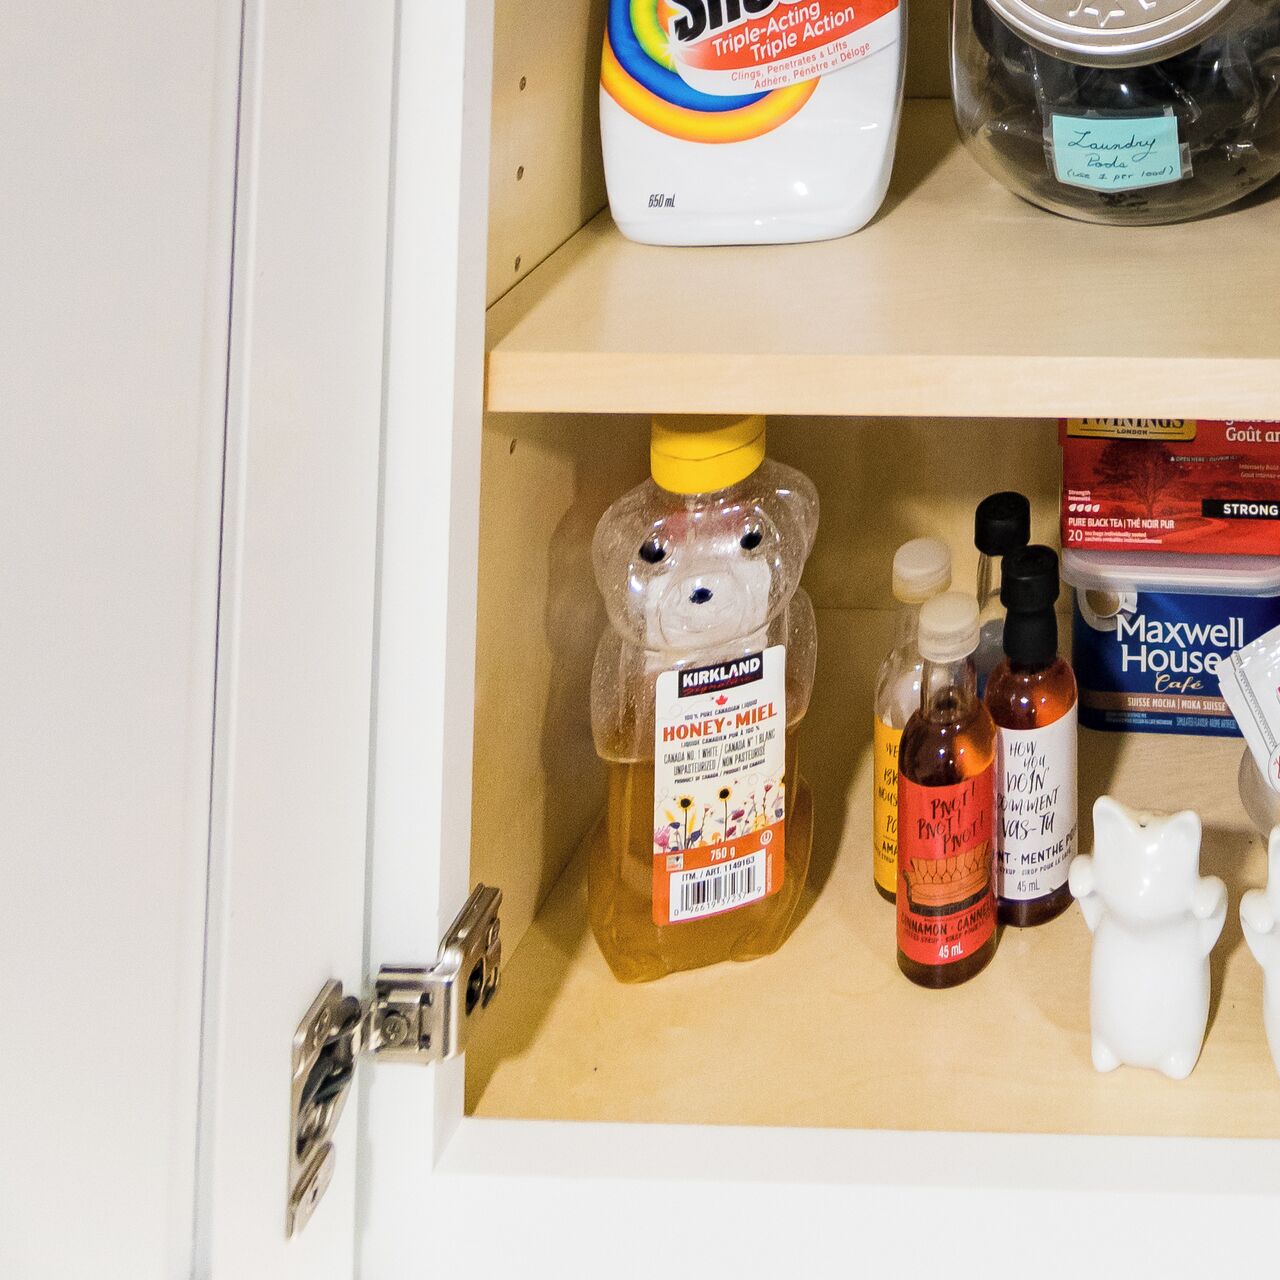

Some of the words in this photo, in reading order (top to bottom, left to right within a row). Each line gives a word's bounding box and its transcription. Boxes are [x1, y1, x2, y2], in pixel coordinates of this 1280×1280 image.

[712, 2, 821, 57] Triple-Acting
[750, 31, 798, 62] Triple
[802, 7, 855, 41] Action
[731, 71, 764, 81] Clings,
[768, 55, 817, 74] Penetrates
[828, 40, 848, 56] Lifts
[1068, 131, 1157, 162] Laundry
[1086, 153, 1127, 168] Pods
[649, 194, 664, 208] 650
[665, 194, 675, 208] mL
[1226, 427, 1262, 443] Goût
[1223, 504, 1278, 516] STRONG
[1088, 518, 1108, 527] BLACK
[1110, 518, 1123, 527] TEA
[1068, 529, 1083, 541] 20
[1116, 614, 1243, 647] Maxwell
[1122, 644, 1219, 674] House
[682, 657, 760, 688] KIRKLAND
[1155, 673, 1203, 692] Café
[1128, 697, 1150, 707] SUISSE
[1152, 698, 1176, 708] MOCHA
[663, 717, 725, 742] HONEY
[735, 702, 777, 729] MIEL
[1009, 740, 1037, 757] HOW
[1021, 839, 1064, 865] MENTHE
[1017, 881, 1027, 893] 45
[1029, 879, 1040, 892] mL
[938, 944, 950, 959] 45
[951, 941, 963, 957] mL
